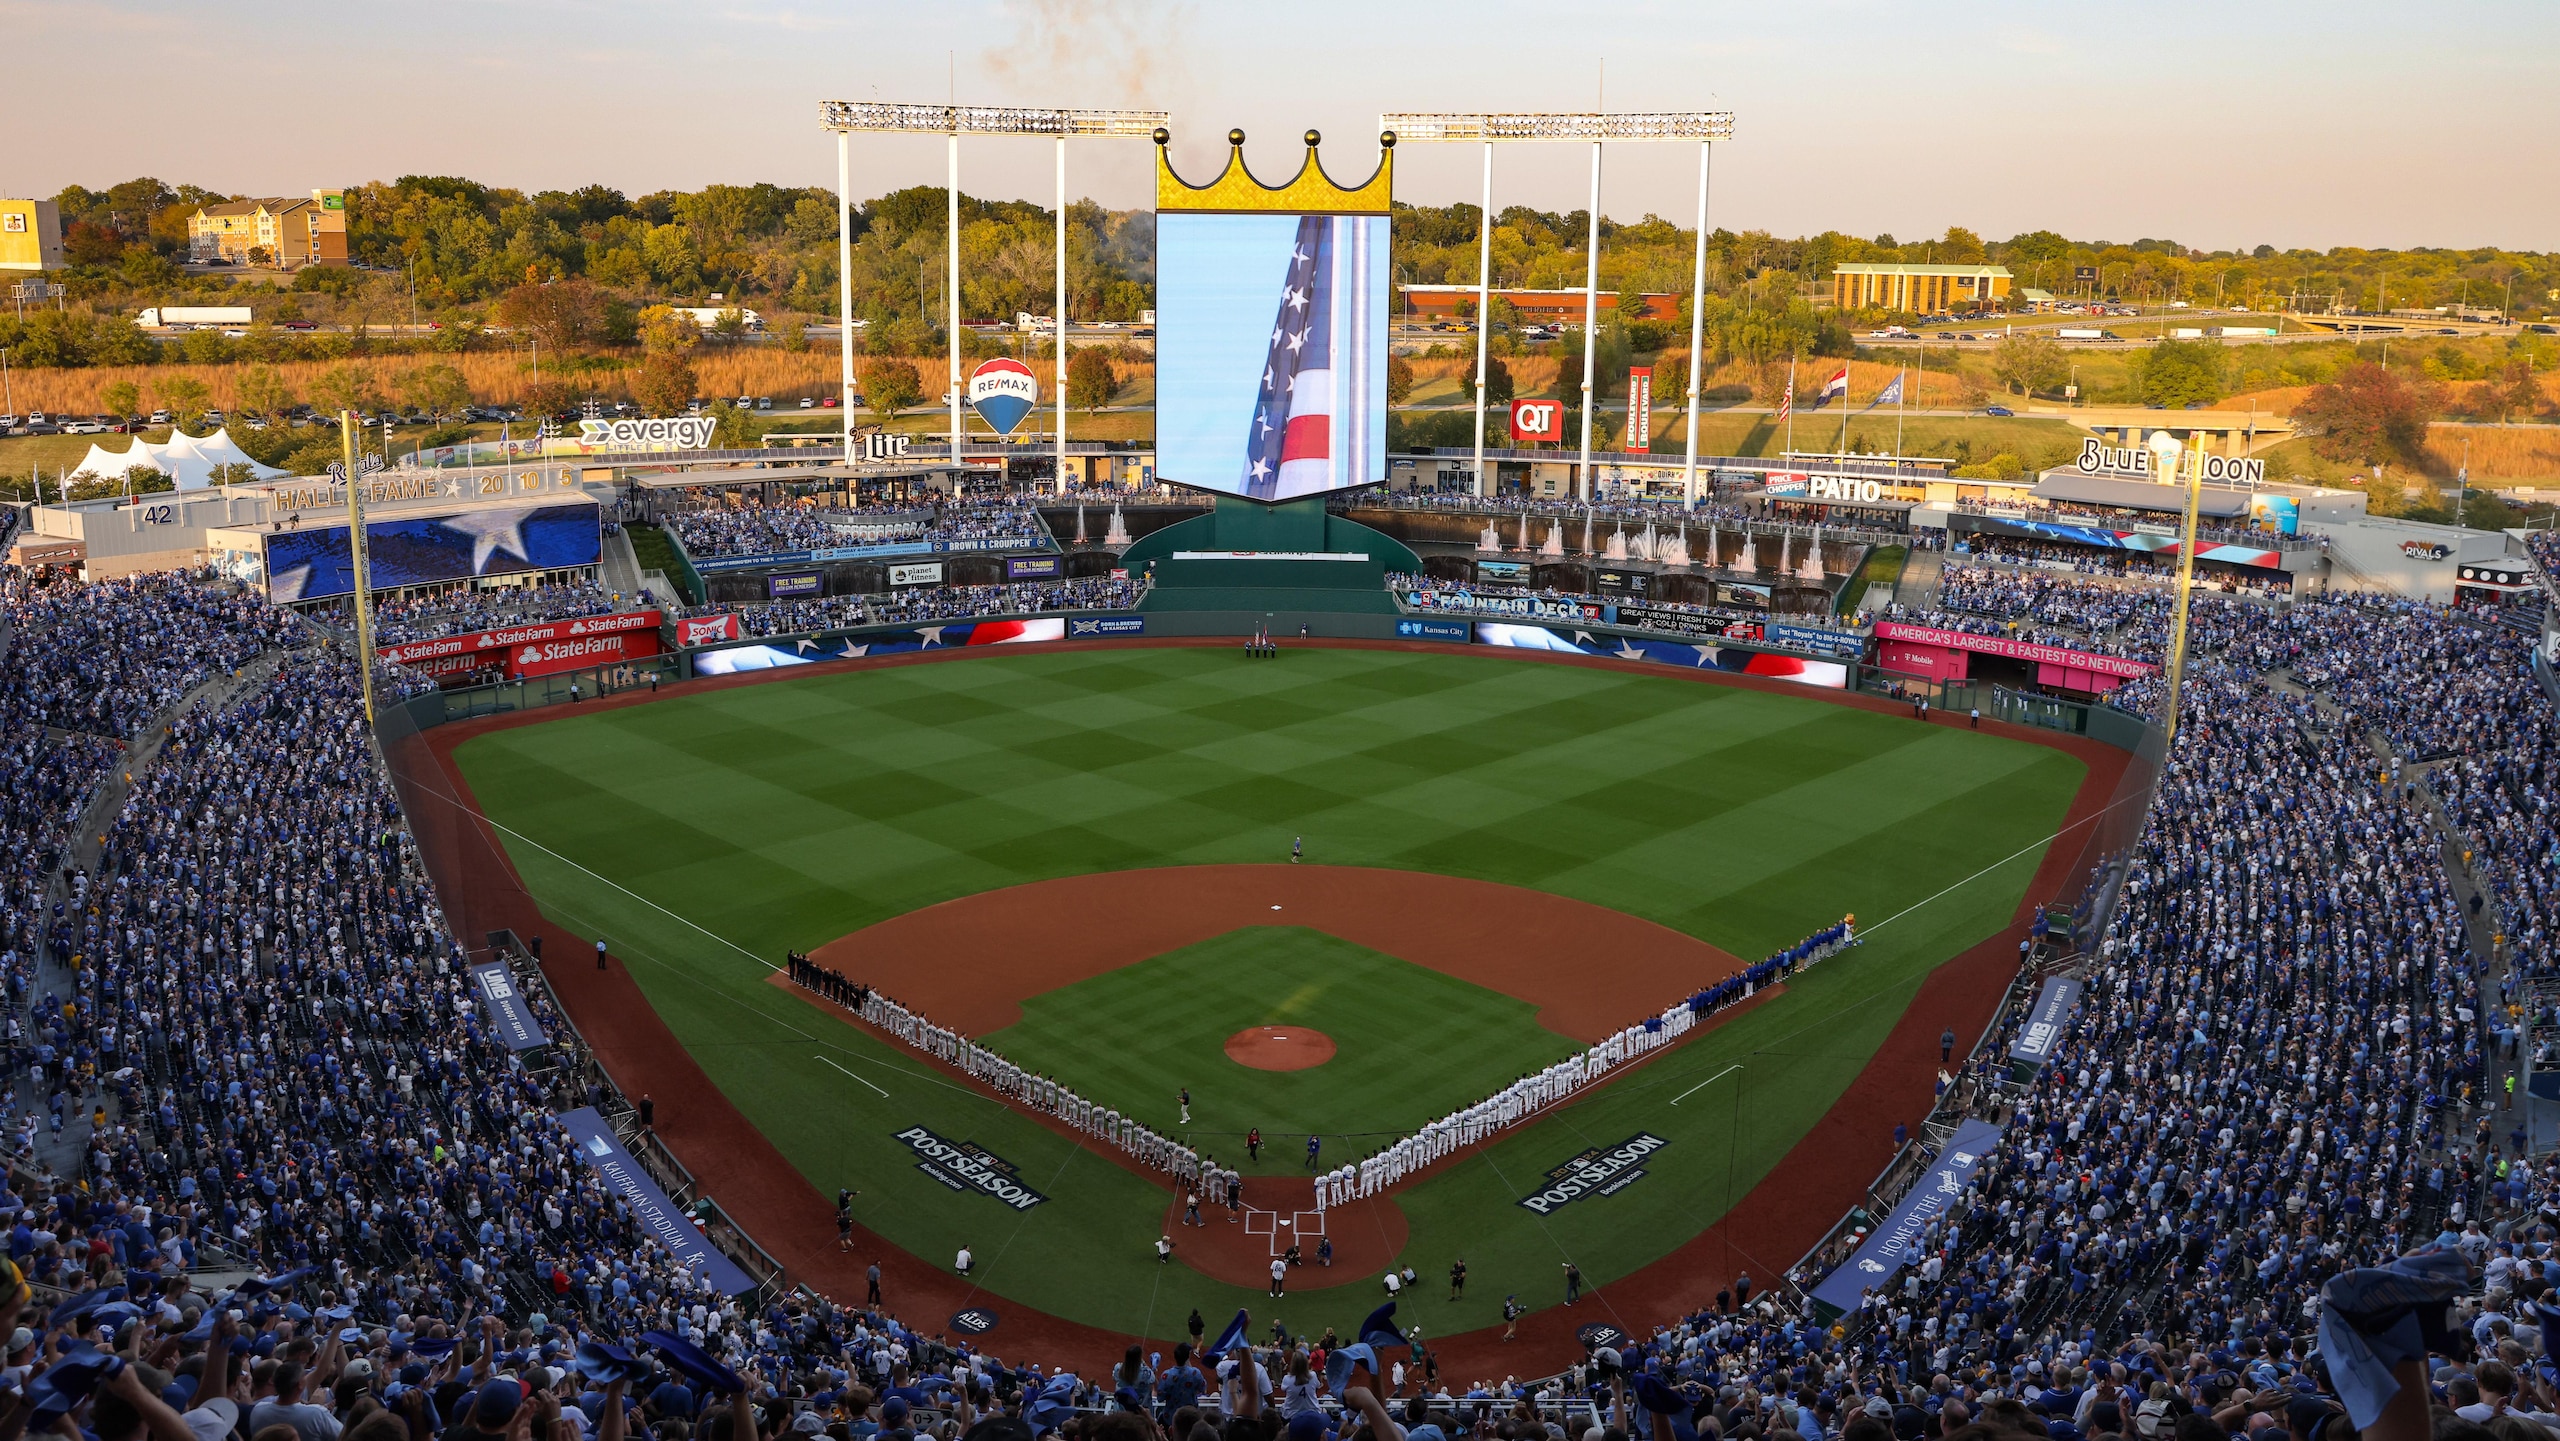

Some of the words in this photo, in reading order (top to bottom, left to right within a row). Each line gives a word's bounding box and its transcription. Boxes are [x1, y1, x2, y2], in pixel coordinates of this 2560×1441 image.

[978, 379, 1028, 392] RE/MAX
[1516, 404, 1554, 433] QT
[1627, 381, 1637, 441] BOULEVARD
[1640, 381, 1649, 440] BOULEVARD
[615, 420, 714, 446] evergy
[850, 425, 882, 442] Miller
[862, 433, 910, 464] Lite
[2078, 438, 2147, 472] BLUE
[480, 475, 504, 494] 20
[520, 471, 539, 490] 10
[560, 469, 573, 487] 5
[1768, 474, 1792, 484] PRICE
[370, 478, 438, 502] FAME
[1767, 482, 1806, 494] CHOPPER
[1810, 476, 1881, 502] PATIO
[275, 486, 344, 511] HALL
[144, 505, 172, 525] 42
[950, 541, 977, 550] BROWN
[980, 541, 986, 549] &
[988, 539, 1031, 548] CROUPPEN
[2406, 546, 2442, 559] RIVALS
[908, 567, 932, 576] planet
[1014, 561, 1027, 569] FREE
[1028, 560, 1054, 568] TRAINING
[790, 576, 817, 585] TRAINING
[1440, 596, 1529, 614] FOUNTAIN
[1534, 602, 1580, 616] DECK
[1584, 607, 1598, 618] QT
[1621, 608, 1646, 617] GREAT
[1647, 611, 1671, 620] VIEWS
[1677, 615, 1701, 624] FRESH
[1703, 618, 1725, 626] FOOD
[692, 625, 723, 636] SONIC
[1424, 626, 1449, 635] Kansas
[1450, 627, 1464, 637] City
[1678, 622, 1707, 632] DRINKS
[1778, 627, 1790, 636] Text
[1791, 629, 1815, 640] "Royals"
[1889, 626, 1950, 645] AMERICA'S
[1953, 635, 2003, 653] LARGEST
[2006, 644, 2015, 655] &
[2018, 645, 2067, 663] FASTEST
[2069, 653, 2085, 667] 5G
[2088, 657, 2148, 677] NETWORK
[1911, 654, 1934, 665] Mobile
[484, 969, 513, 999] UMB
[2044, 1002, 2060, 1021] DUGOUT
[2054, 985, 2068, 1001] SUITES
[500, 1000, 518, 1021] DUGOUT
[512, 1021, 529, 1041] SUITES
[2020, 1022, 2052, 1054] UMB
[962, 1144, 980, 1154] 20
[1583, 1150, 1599, 1160] 24
[897, 1128, 1041, 1209] POSTSEASON
[920, 1163, 963, 1190] Booking.com
[998, 1163, 1013, 1173] 24
[1523, 1135, 1665, 1213] POSTSEASON
[1551, 1168, 1568, 1178] 20
[1600, 1169, 1644, 1195] Booking.com
[602, 1161, 653, 1207] KAUFFMAN
[642, 1205, 689, 1249] STADIUM
[1878, 1226, 1914, 1257] HOME
[1904, 1212, 1924, 1227] OF
[1914, 1194, 1942, 1213] THE
[1937, 1170, 1962, 1195] Royals
[958, 1312, 989, 1329] ALDS
[1594, 1327, 1615, 1343] LDS
[1299, 1386, 1306, 1398] 4
